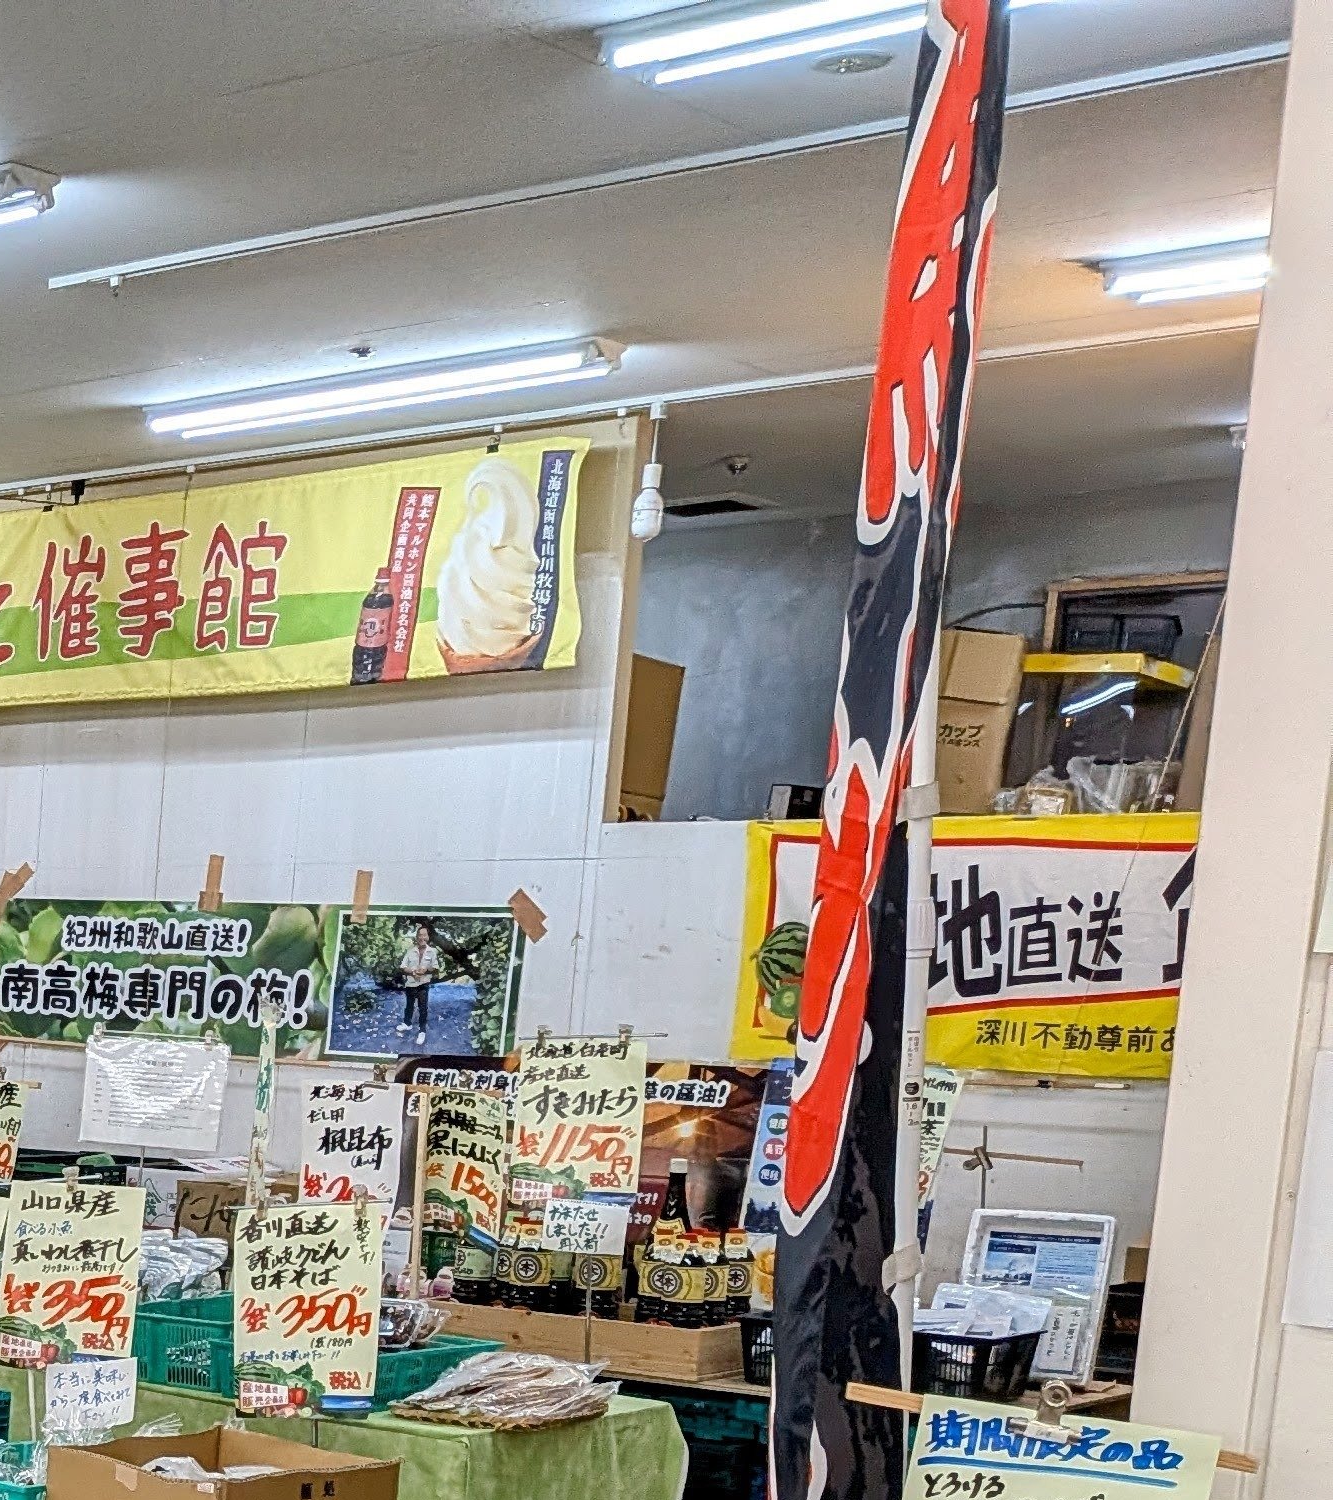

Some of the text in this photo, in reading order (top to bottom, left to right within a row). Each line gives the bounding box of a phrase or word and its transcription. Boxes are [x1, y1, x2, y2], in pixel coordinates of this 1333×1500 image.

[63, 918, 249, 955] 紀州和歌山直送!
[0, 963, 313, 1026] 南高梅専門の梅!
[523, 1084, 639, 1124] すきみたら
[21, 1189, 120, 1219] 山口県産
[237, 1210, 339, 1243] 香川直送
[250, 1265, 341, 1291] 日本そば
[923, 1471, 1005, 1500] とろける
